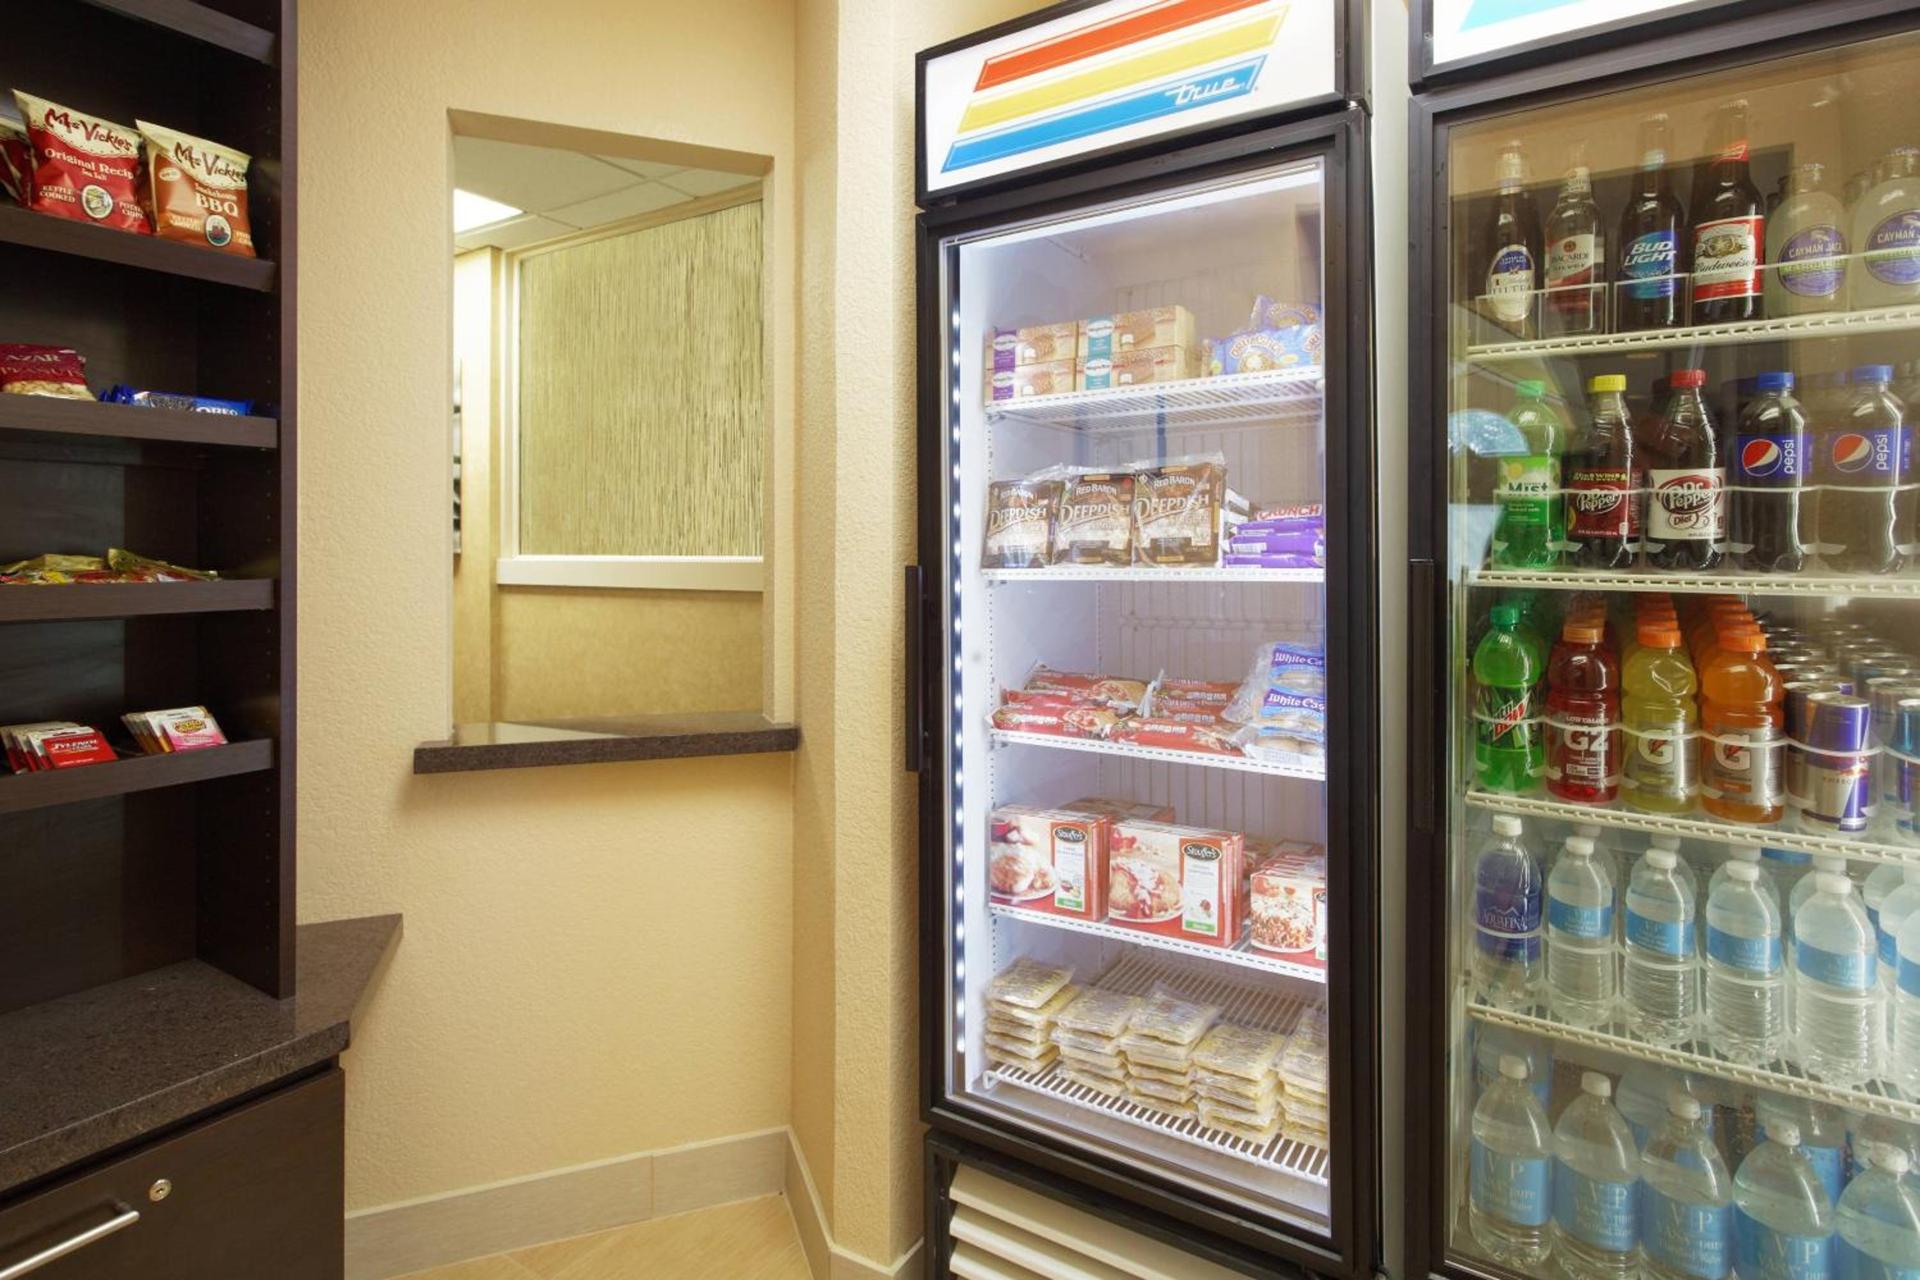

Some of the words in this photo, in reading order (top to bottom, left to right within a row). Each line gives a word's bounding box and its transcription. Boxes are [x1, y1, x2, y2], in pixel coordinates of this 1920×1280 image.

[1164, 77, 1244, 105] True
[79, 120, 133, 151] Vickie's
[45, 148, 96, 171] Original
[99, 163, 134, 180] Recip
[195, 192, 238, 218] BBQ
[1877, 230, 1916, 244] CAYMAN
[1631, 241, 1673, 254] BUD
[1789, 243, 1824, 258] CAYMAN
[1624, 251, 1677, 266] LIGHT
[1783, 439, 1797, 474] pepsi
[1876, 434, 1889, 470] pepsi
[1153, 477, 1169, 487] RED
[1169, 475, 1196, 487] BARON
[1076, 486, 1091, 496] RED
[1091, 485, 1117, 496] BARON
[1257, 504, 1322, 520] CRUNCH
[1673, 515, 1692, 526] Diet
[1275, 652, 1307, 666] White
[1269, 692, 1302, 708] White
[1564, 727, 1608, 752] G2
[1639, 729, 1673, 764] G
[1715, 734, 1750, 770] G
